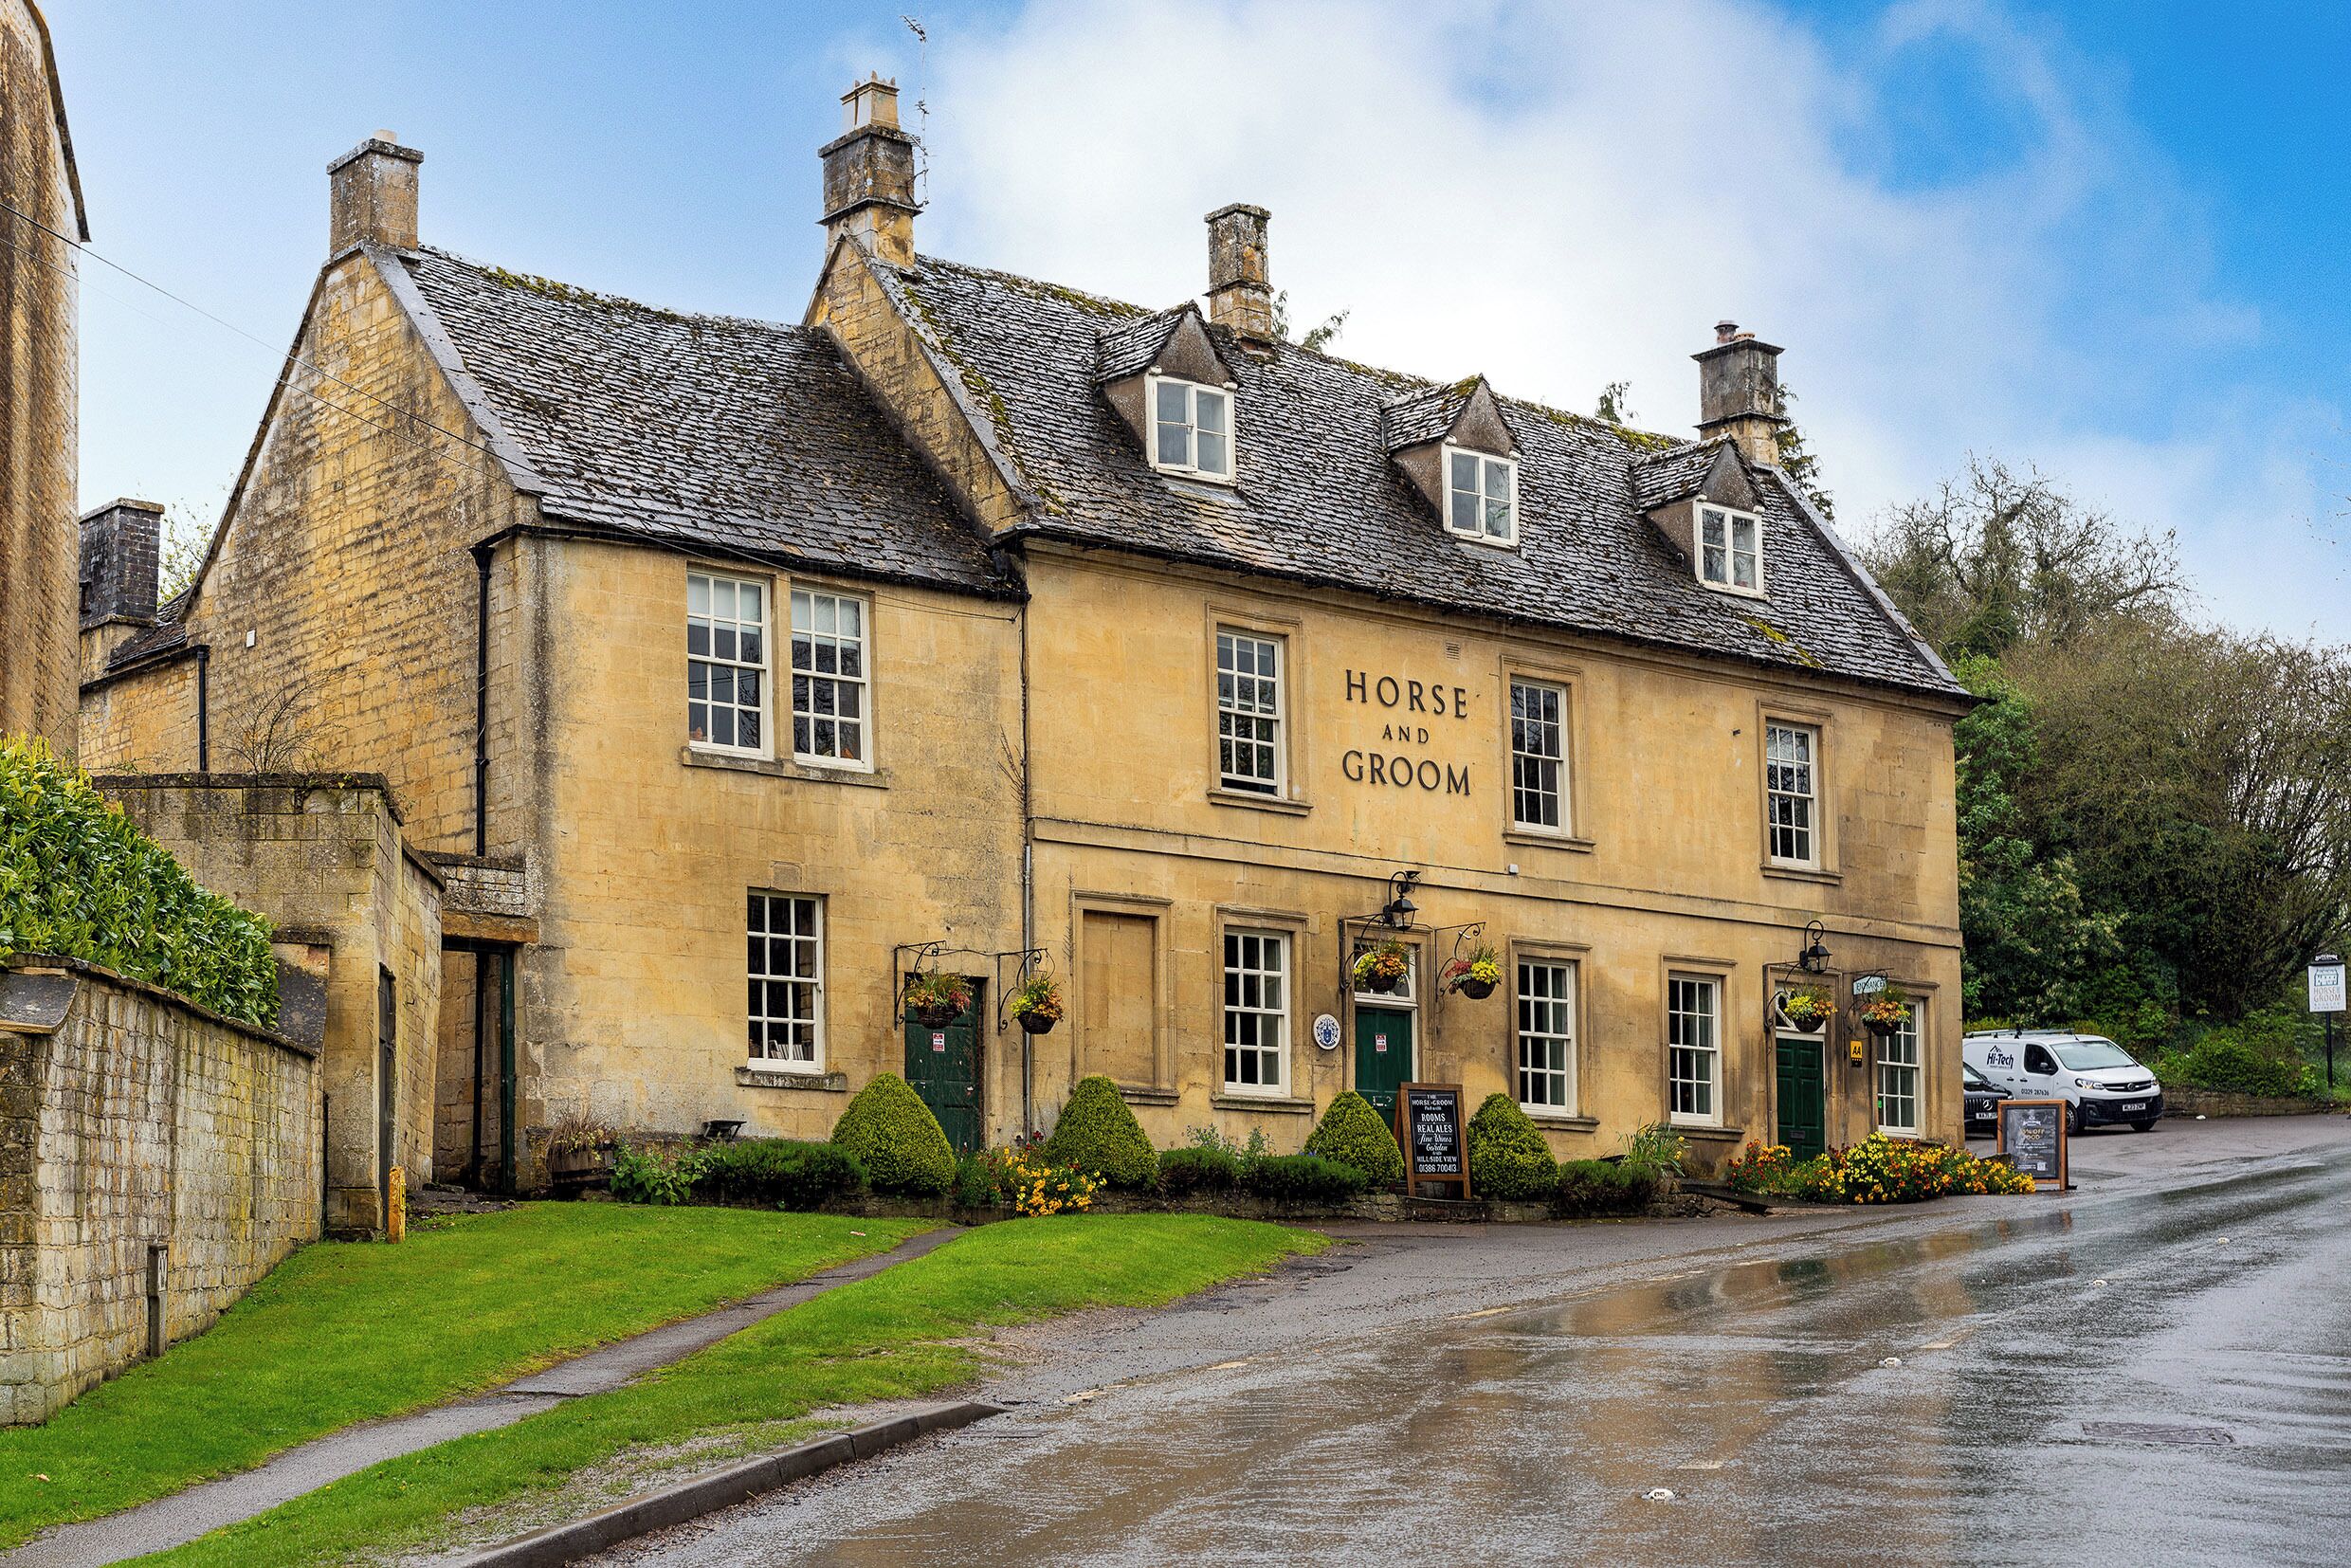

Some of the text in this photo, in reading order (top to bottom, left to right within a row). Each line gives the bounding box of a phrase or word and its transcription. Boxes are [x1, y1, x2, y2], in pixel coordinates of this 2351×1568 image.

[1345, 668, 1468, 719] HORSE
[1382, 723, 1430, 744] AND
[1342, 750, 1471, 796] GROOM
[2313, 994, 2342, 1003] GROOM
[1852, 1046, 1862, 1055] AA
[1987, 1052, 2014, 1069] Hi-Tech
[1421, 1113, 1446, 1122] ROOMS
[1417, 1124, 1453, 1133] REAL ALES
[1418, 1163, 1457, 1173] 01386 700413
